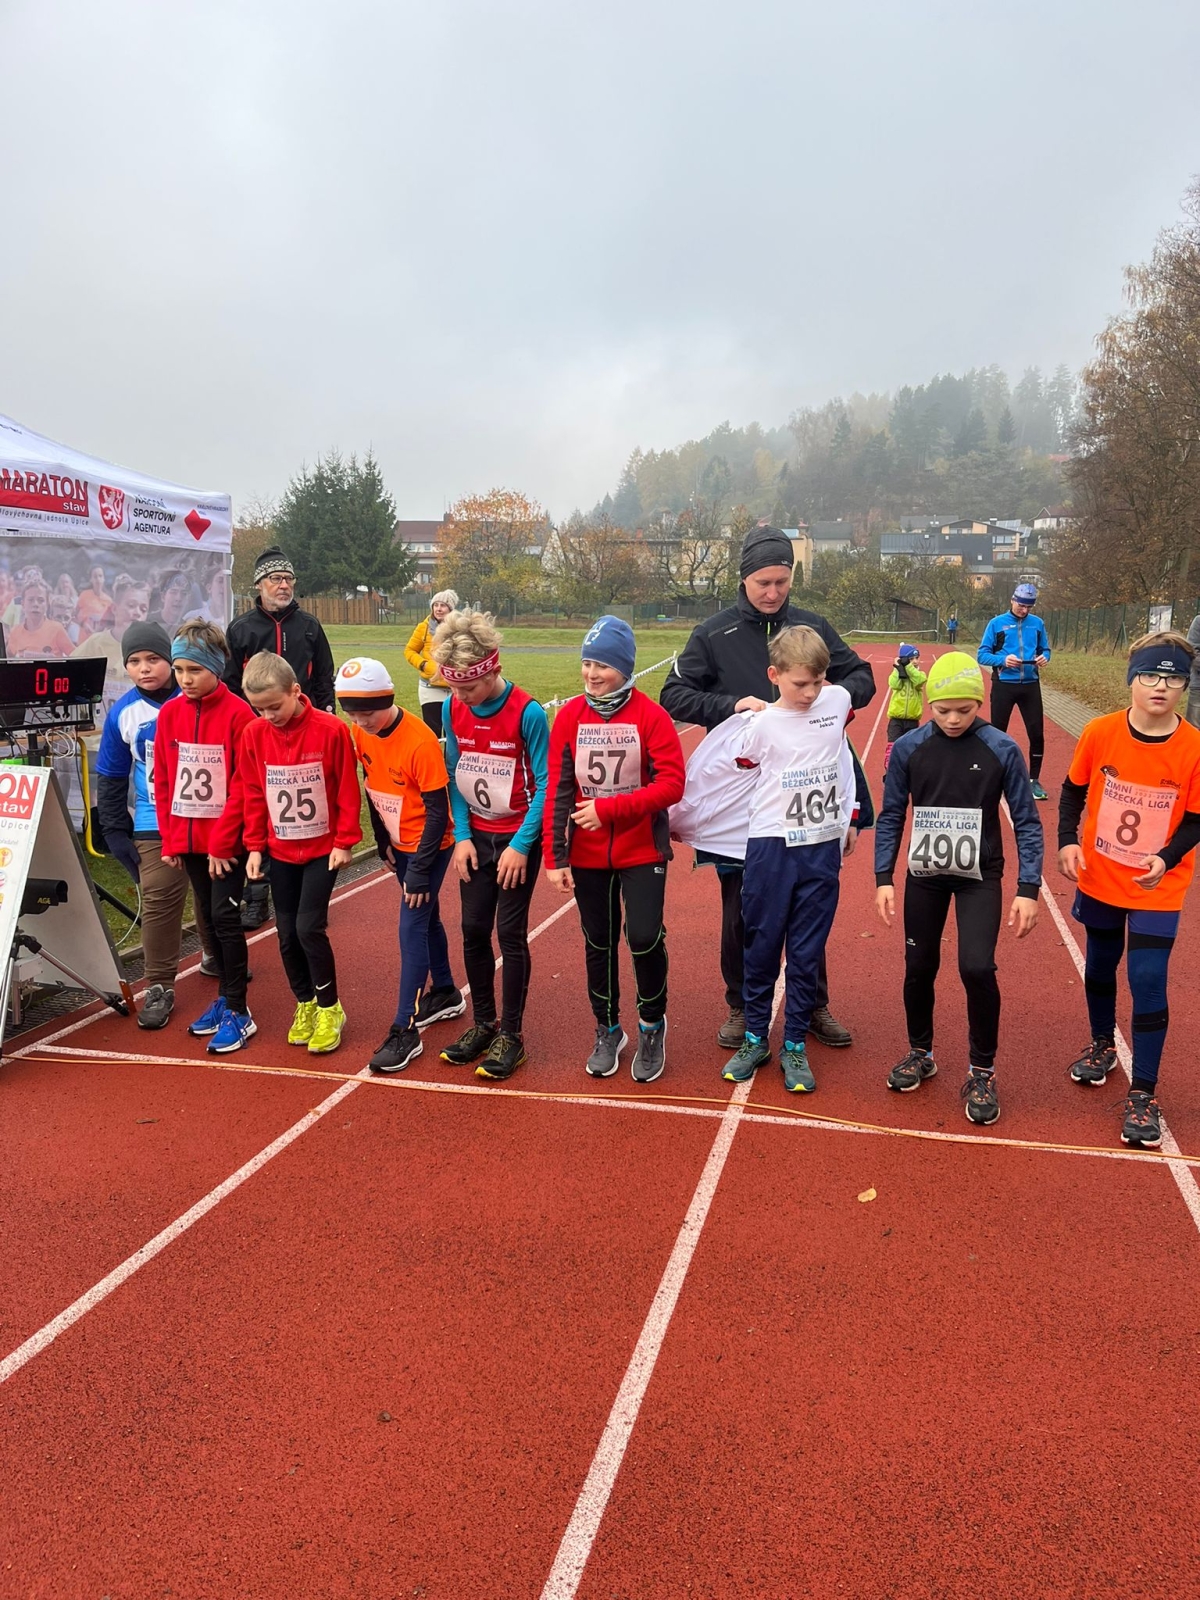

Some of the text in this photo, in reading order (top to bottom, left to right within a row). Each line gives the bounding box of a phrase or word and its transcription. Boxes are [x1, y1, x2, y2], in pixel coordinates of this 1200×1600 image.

[63, 501, 86, 512] stav
[133, 507, 176, 522] SPORTOVNÍ
[133, 522, 171, 536] AGENTURA
[443, 660, 493, 679] ROCKS
[54, 677, 70, 694] 00
[579, 727, 601, 736] ZIMNÍ
[578, 735, 637, 745] BĚŽECKÁ LIGA
[203, 756, 223, 764] LIGA
[267, 768, 286, 777] ZIMNÍ
[457, 763, 489, 774] BĚŽECKÁ
[492, 767, 511, 777] LIGA
[587, 749, 627, 786] 57
[782, 768, 809, 780] ZIMNÍ
[179, 766, 213, 802] 23
[267, 777, 299, 786] BĚŽECKÁ
[301, 774, 322, 784] LIGA
[782, 776, 821, 789] BĚŽECKÁ
[823, 772, 838, 784] LIGA
[1106, 779, 1133, 794] ZIMNÍ
[473, 778, 492, 809] 6
[1104, 788, 1170, 809] BĚŽECKÁ LIGA
[277, 787, 317, 823] 25
[382, 804, 398, 814] LIGA
[785, 785, 840, 827] 464
[916, 810, 940, 819] ZIMNÍ
[1, 818, 30, 831] Úpice
[914, 819, 978, 830] BĚŽECKÁ LIGA
[1115, 809, 1141, 847] 8
[911, 833, 977, 871] 490
